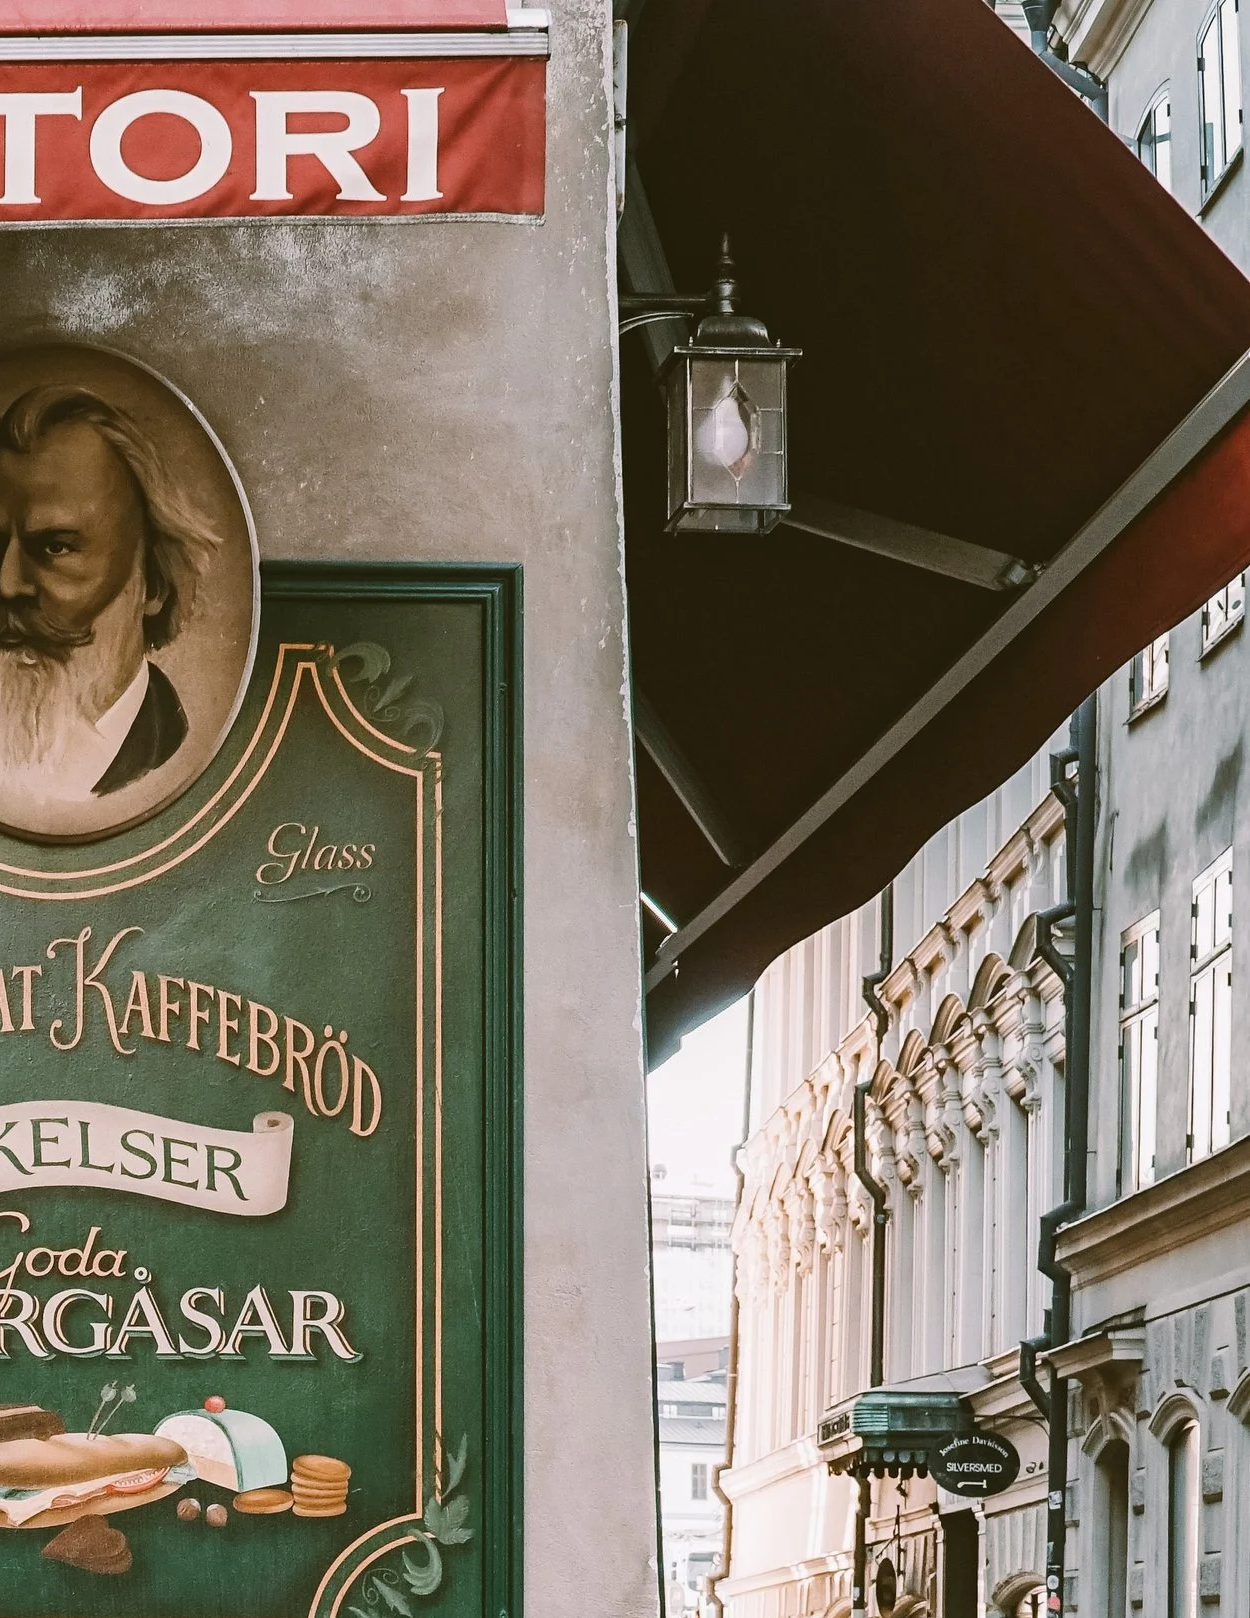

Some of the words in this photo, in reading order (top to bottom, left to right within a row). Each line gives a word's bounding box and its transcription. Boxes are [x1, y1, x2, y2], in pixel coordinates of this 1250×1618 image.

[255, 822, 376, 885] Glass
[46, 925, 383, 1138] KAFFEBRÖD
[938, 1437, 970, 1457] Josefine
[946, 1462, 1003, 1473] SILVERSMED
